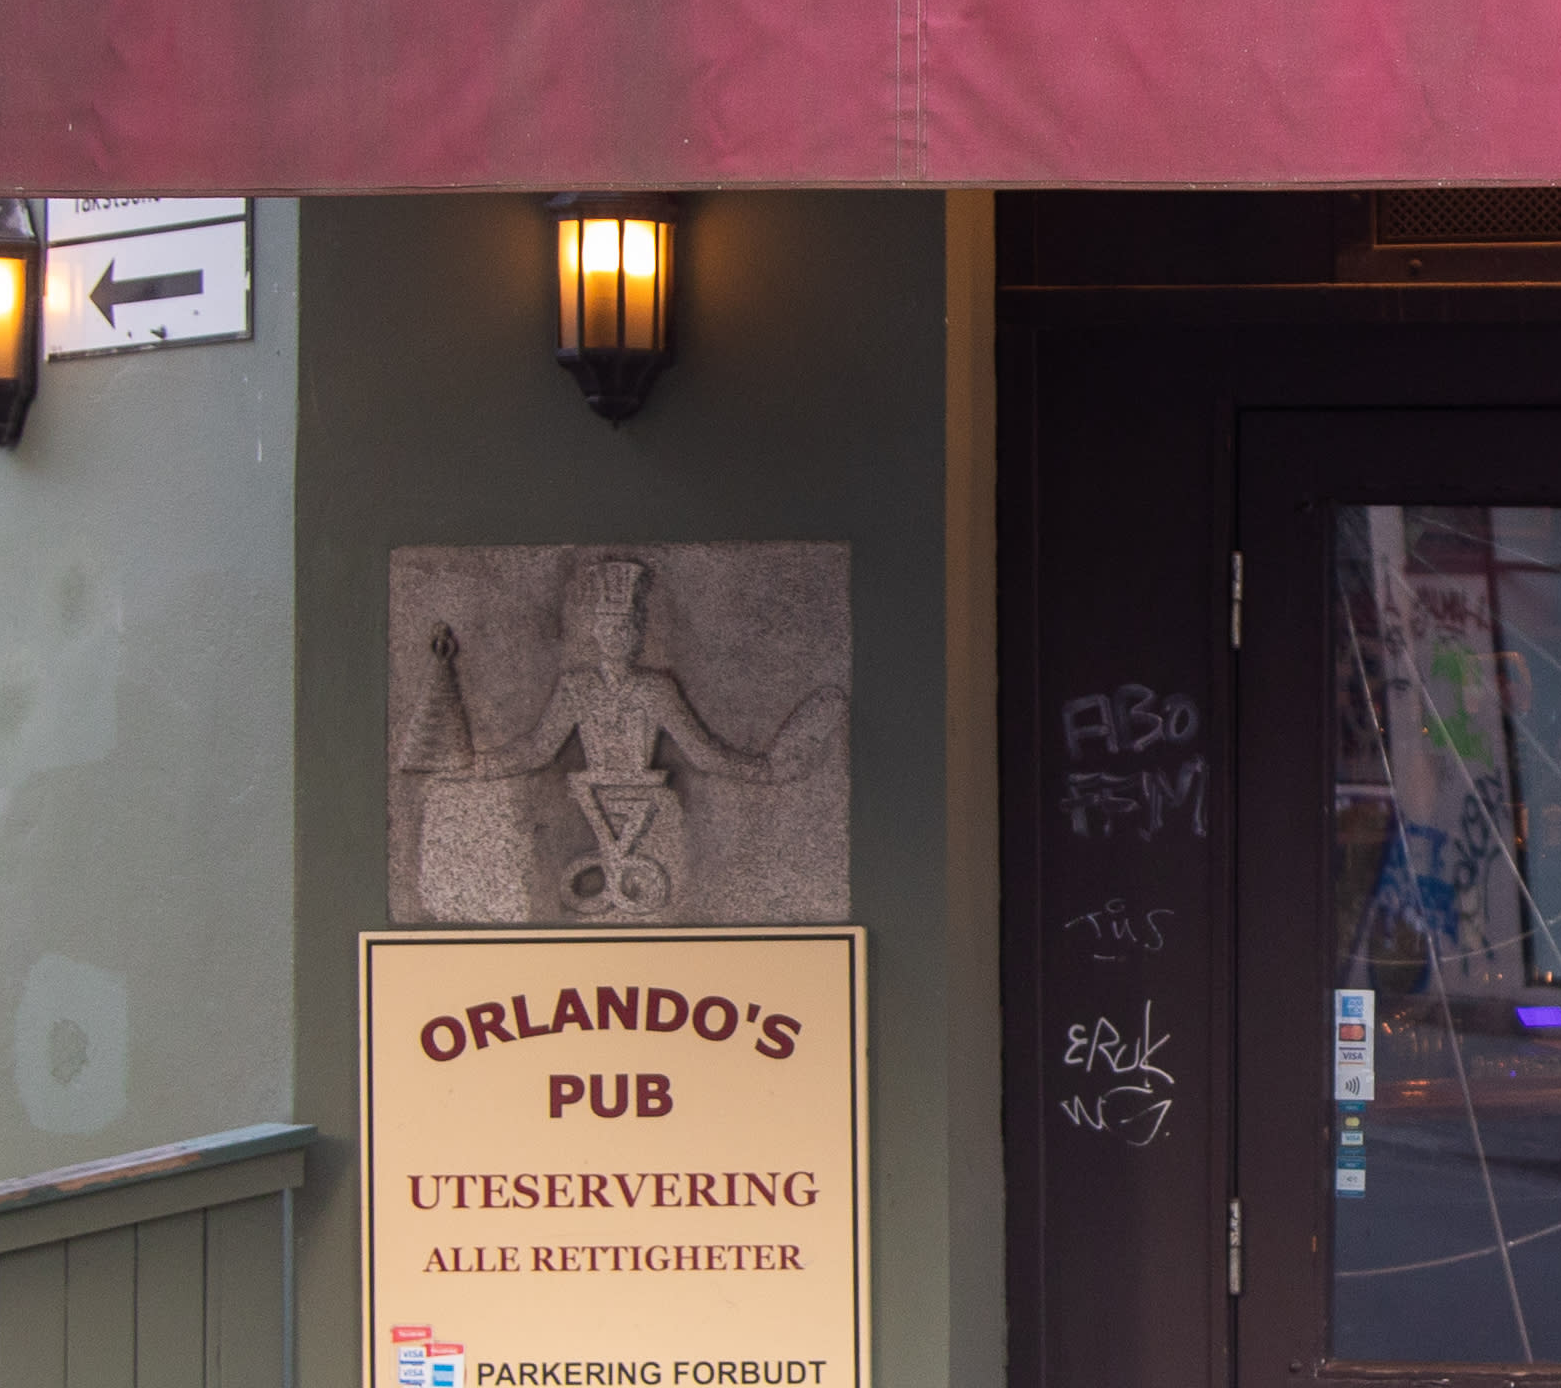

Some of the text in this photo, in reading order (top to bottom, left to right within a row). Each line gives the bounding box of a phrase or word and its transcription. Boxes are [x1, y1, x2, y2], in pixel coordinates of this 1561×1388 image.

[419, 985, 803, 1062] ORLANDO'S
[1343, 1052, 1364, 1060] VISA
[548, 1073, 674, 1119] PUB
[407, 1171, 821, 1210] UTESERVERING
[422, 1244, 805, 1273] ALLE RETTIGHETER
[477, 1360, 827, 1386] PARKERING FORBUDT
